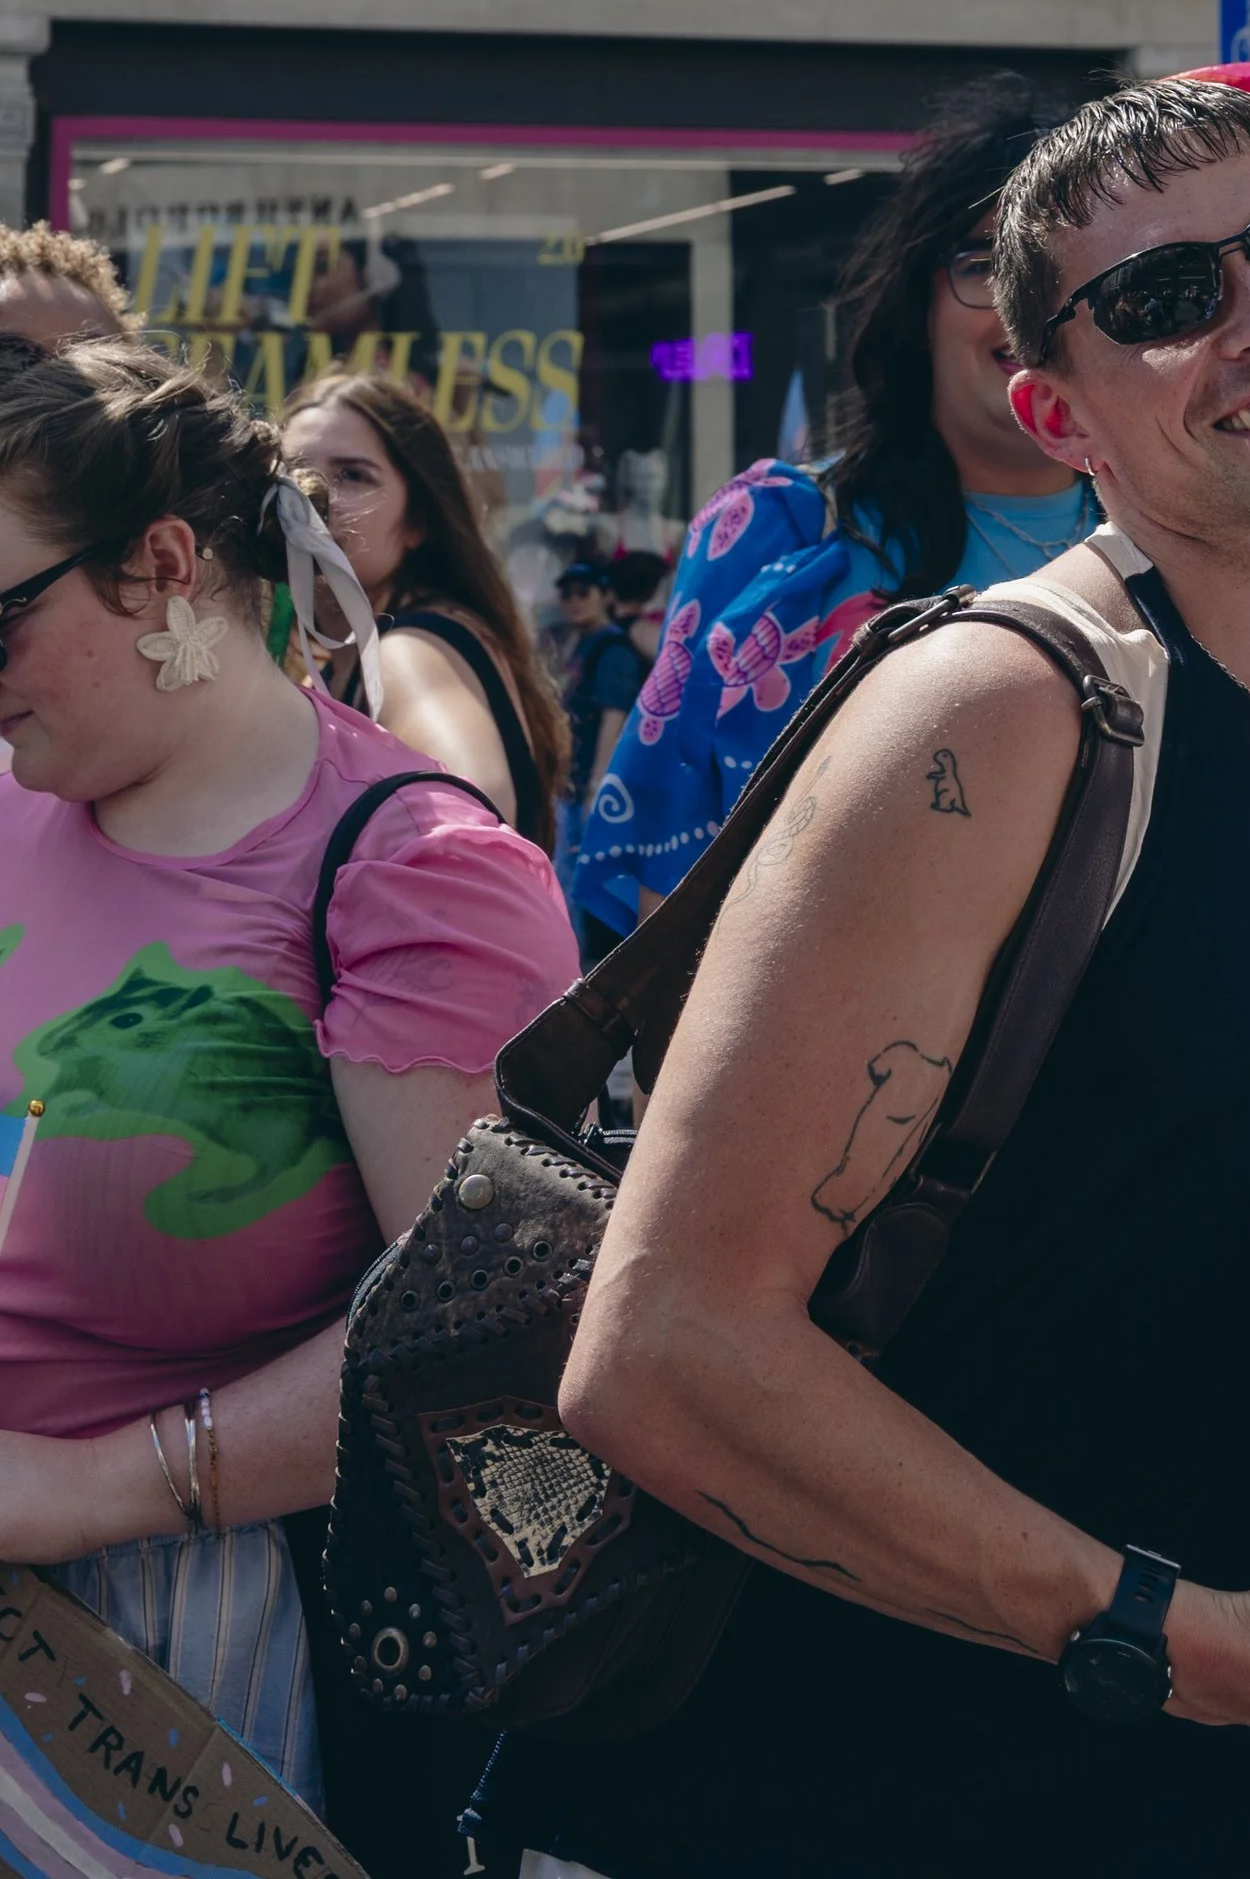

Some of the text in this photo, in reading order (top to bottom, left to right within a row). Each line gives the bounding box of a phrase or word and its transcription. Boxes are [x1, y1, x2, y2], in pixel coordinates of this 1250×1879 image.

[136, 224, 342, 324] LIFT
[67, 1692, 200, 1820] TRANS
[225, 1811, 340, 1879] LIVE
